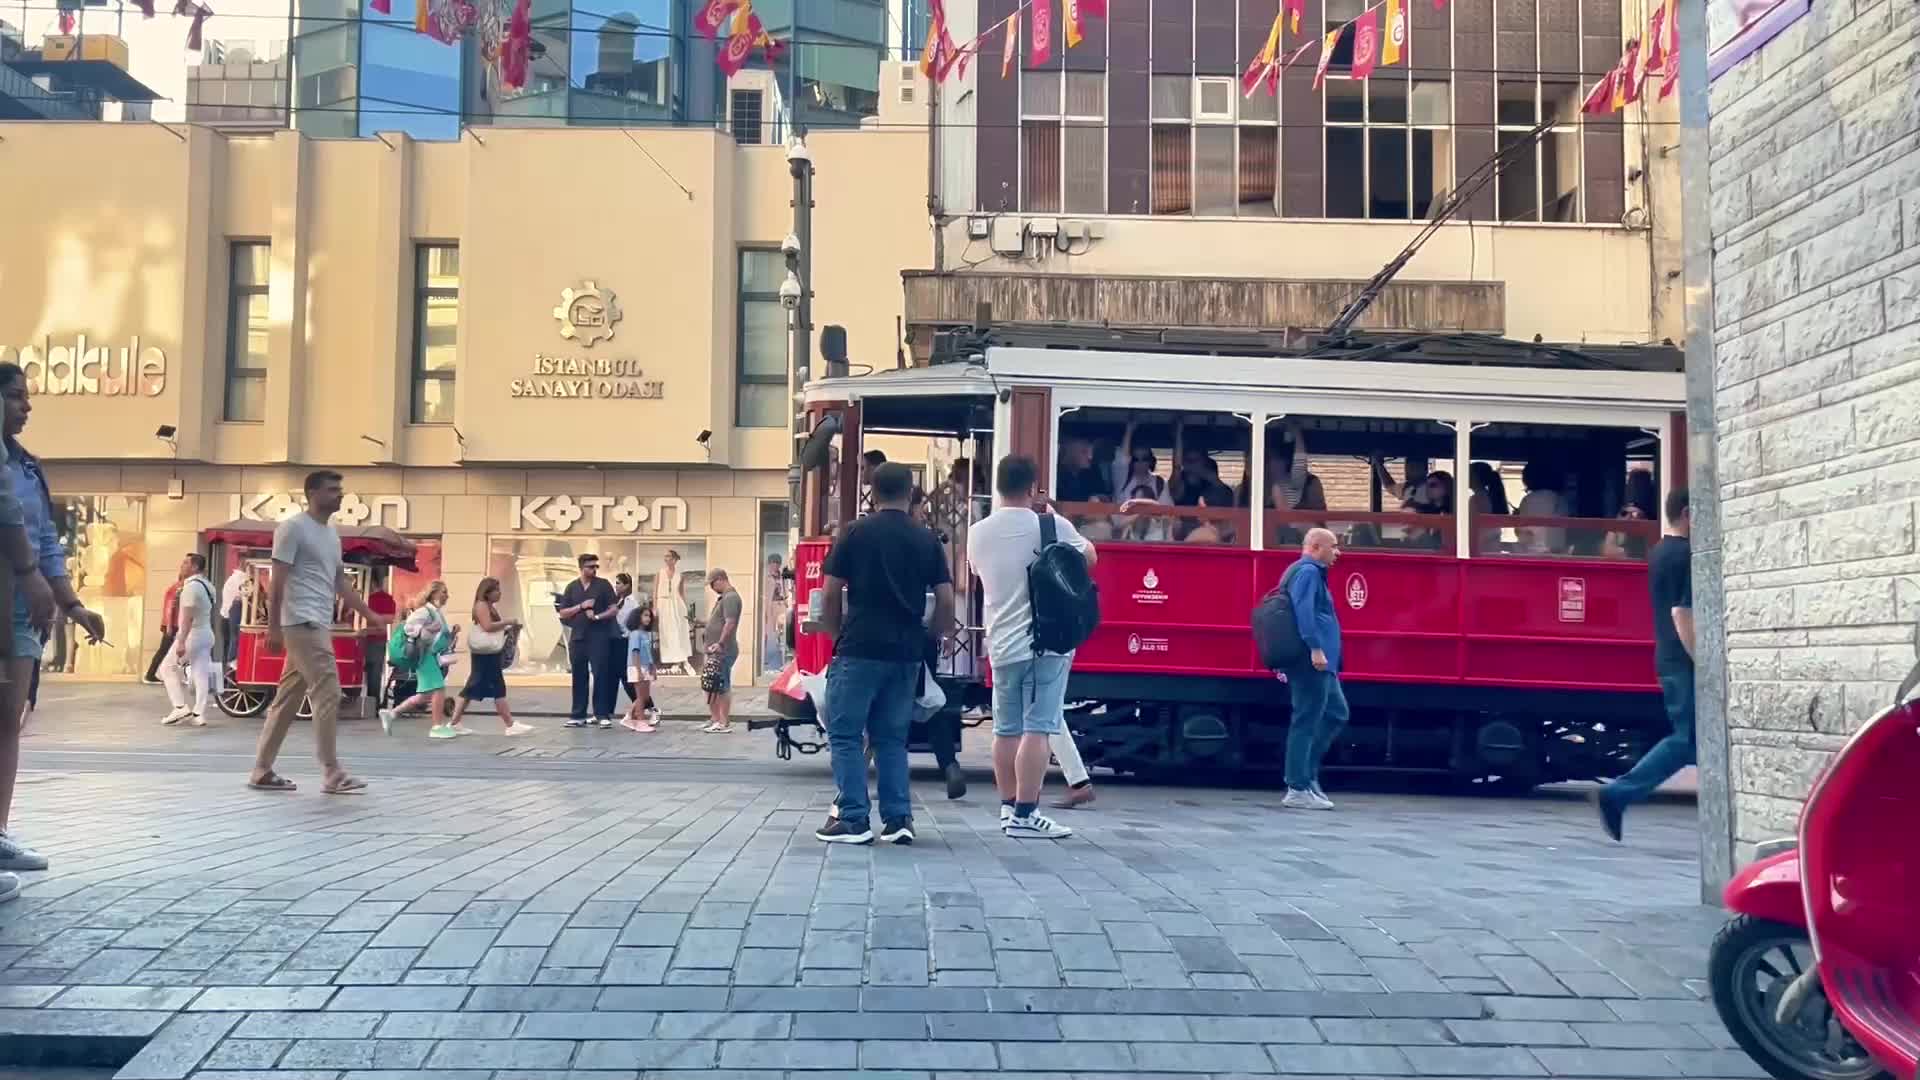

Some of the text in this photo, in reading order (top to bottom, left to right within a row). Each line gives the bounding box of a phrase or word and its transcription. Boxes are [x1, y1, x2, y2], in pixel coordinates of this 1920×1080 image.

[533, 352, 642, 377] İSTANBUL
[511, 378, 664, 399] SANAYİ ODASI
[511, 494, 688, 532] KOTON
